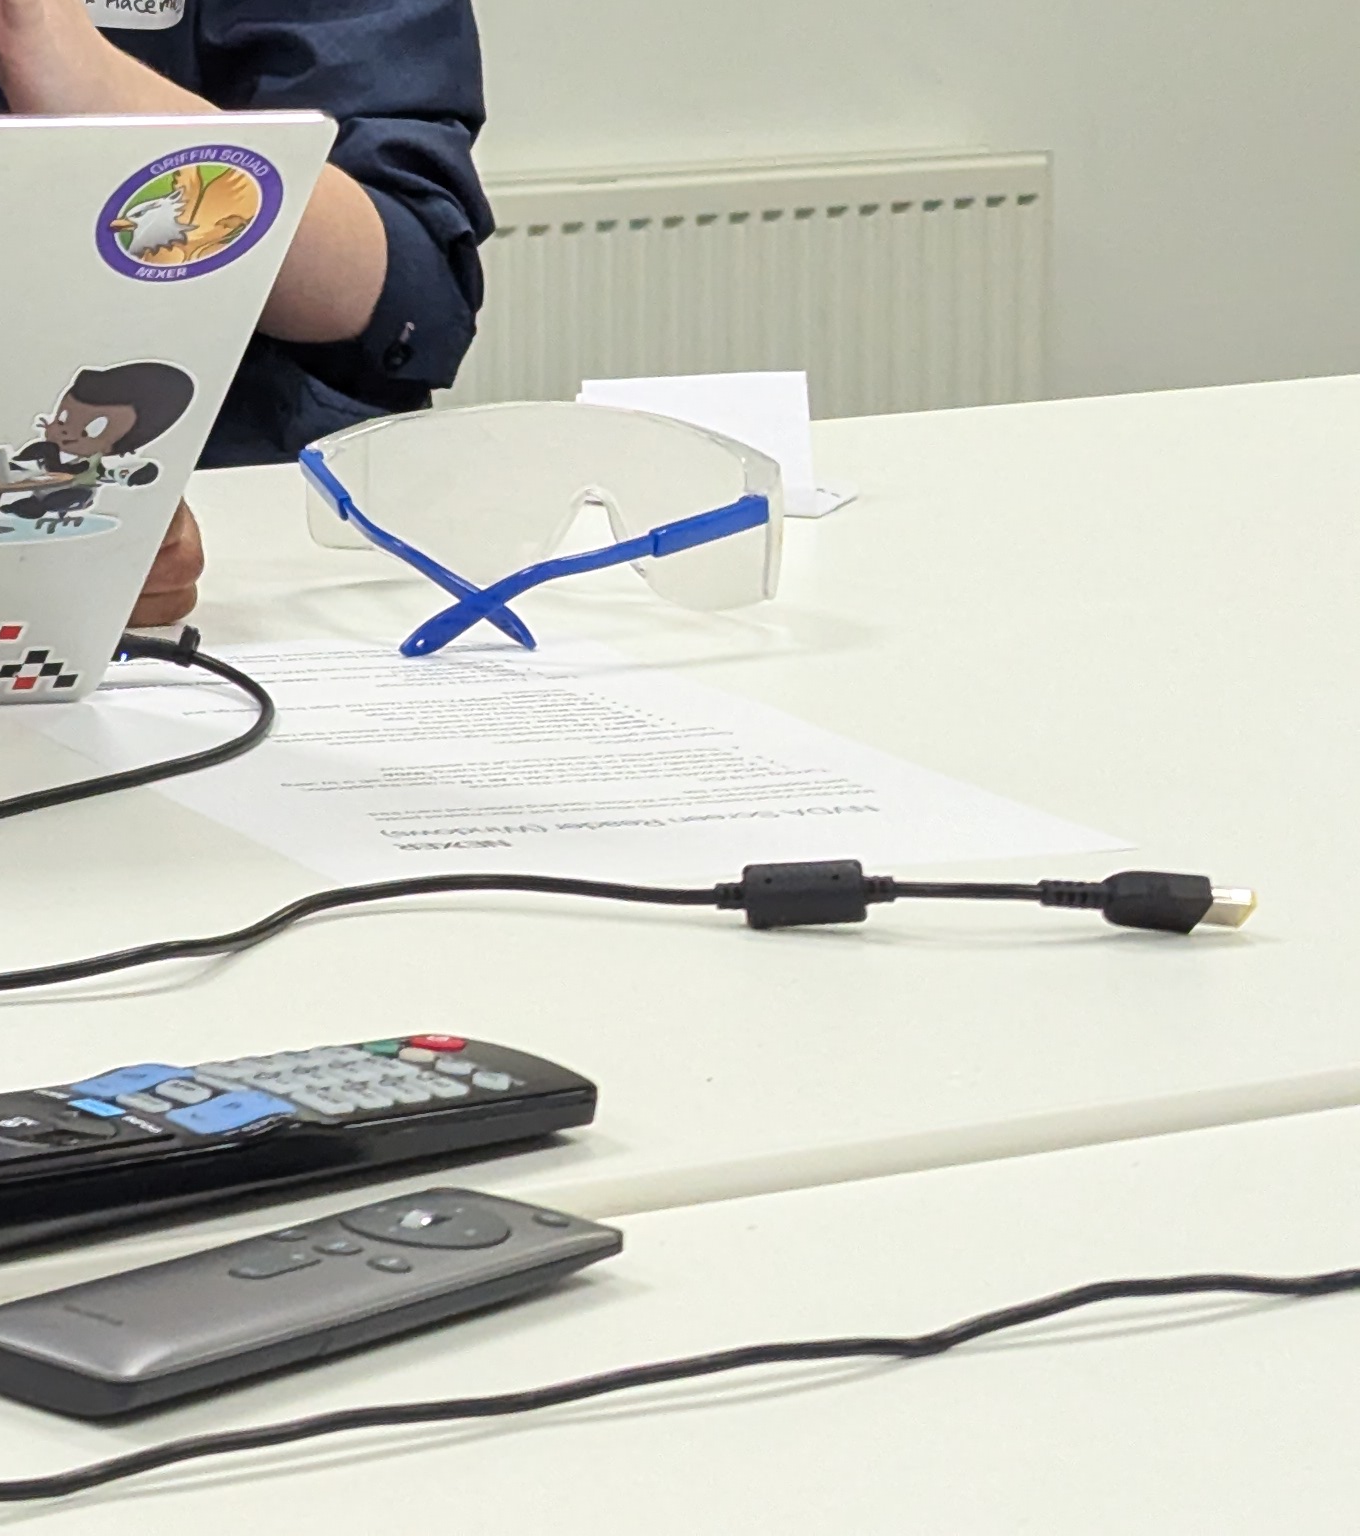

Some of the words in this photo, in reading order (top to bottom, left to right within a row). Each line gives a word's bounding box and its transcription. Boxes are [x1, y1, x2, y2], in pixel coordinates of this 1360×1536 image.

[149, 148, 217, 175] GRIFFIN
[219, 149, 270, 177] SQUAD
[135, 266, 188, 279] NEXER
